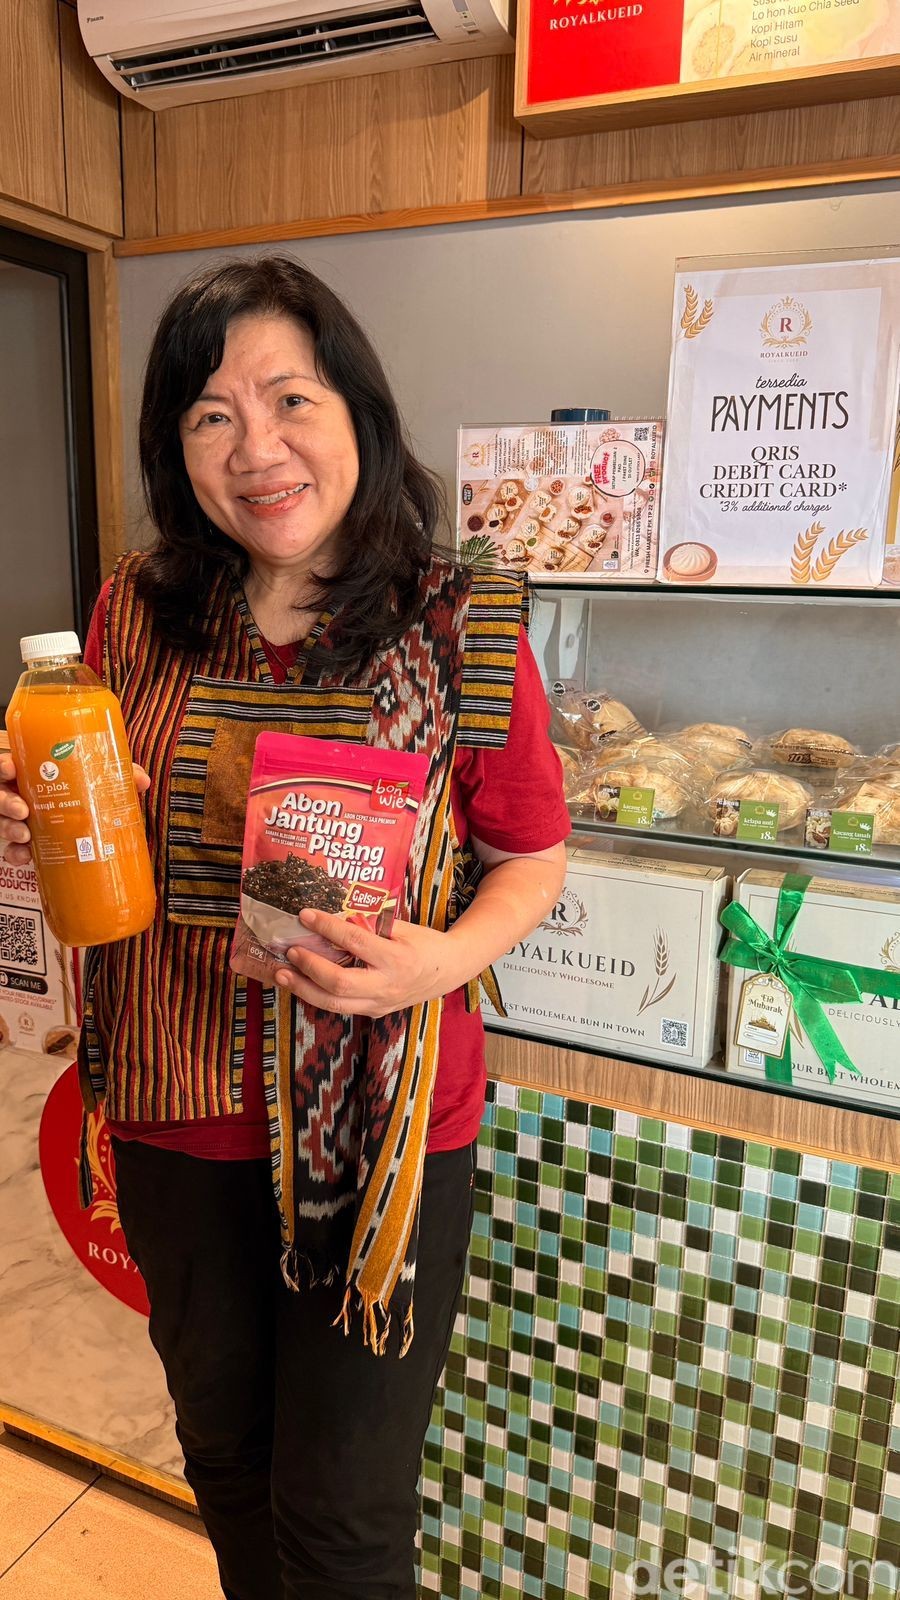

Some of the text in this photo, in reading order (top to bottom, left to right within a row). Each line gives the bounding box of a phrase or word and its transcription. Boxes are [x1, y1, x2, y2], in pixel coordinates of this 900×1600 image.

[550, 4, 643, 30] ROYALKUEID
[752, 11, 765, 20] Lo
[767, 8, 786, 18] hon
[788, 5, 807, 15] kuo
[809, 2, 832, 11] Chia
[751, 19, 804, 34] Kopi Hitam
[750, 34, 798, 48] Kopi Susu
[749, 46, 800, 62] Air mineral
[780, 317, 793, 332] R
[755, 373, 807, 388] tersedia
[710, 391, 849, 432] PAYMENTS
[751, 446, 799, 466] QRIS
[594, 464, 602, 484] FREE
[602, 452, 610, 484] product
[713, 463, 836, 480] DEBIT CARD
[700, 483, 774, 498] CREDIT
[742, 501, 791, 512] additional
[793, 501, 831, 516] charges
[36, 782, 69, 794] D'plok
[375, 778, 402, 796] bon
[58, 799, 81, 808] asem
[281, 792, 342, 819] Abon
[264, 806, 364, 843] Jantung
[308, 834, 385, 867] Pisang
[16, 870, 37, 881] OUR
[327, 858, 385, 885] Wijen
[551, 901, 569, 922] R
[249, 946, 264, 959] 60g
[505, 942, 636, 977] YALKUEID
[10, 977, 41, 990] SCAN ME
[503, 962, 615, 989] DELICIOUSLY WHOLESOME
[748, 998, 783, 1015] Mubarak
[761, 994, 774, 1004] Eid
[504, 1002, 519, 1011] EST
[521, 1006, 577, 1023] WHOLEMEAL
[580, 1017, 600, 1027] BUN
[602, 1021, 613, 1030] IN
[616, 1024, 645, 1036] TOWN
[817, 1067, 845, 1080] BT
[88, 1241, 139, 1273] ROY
